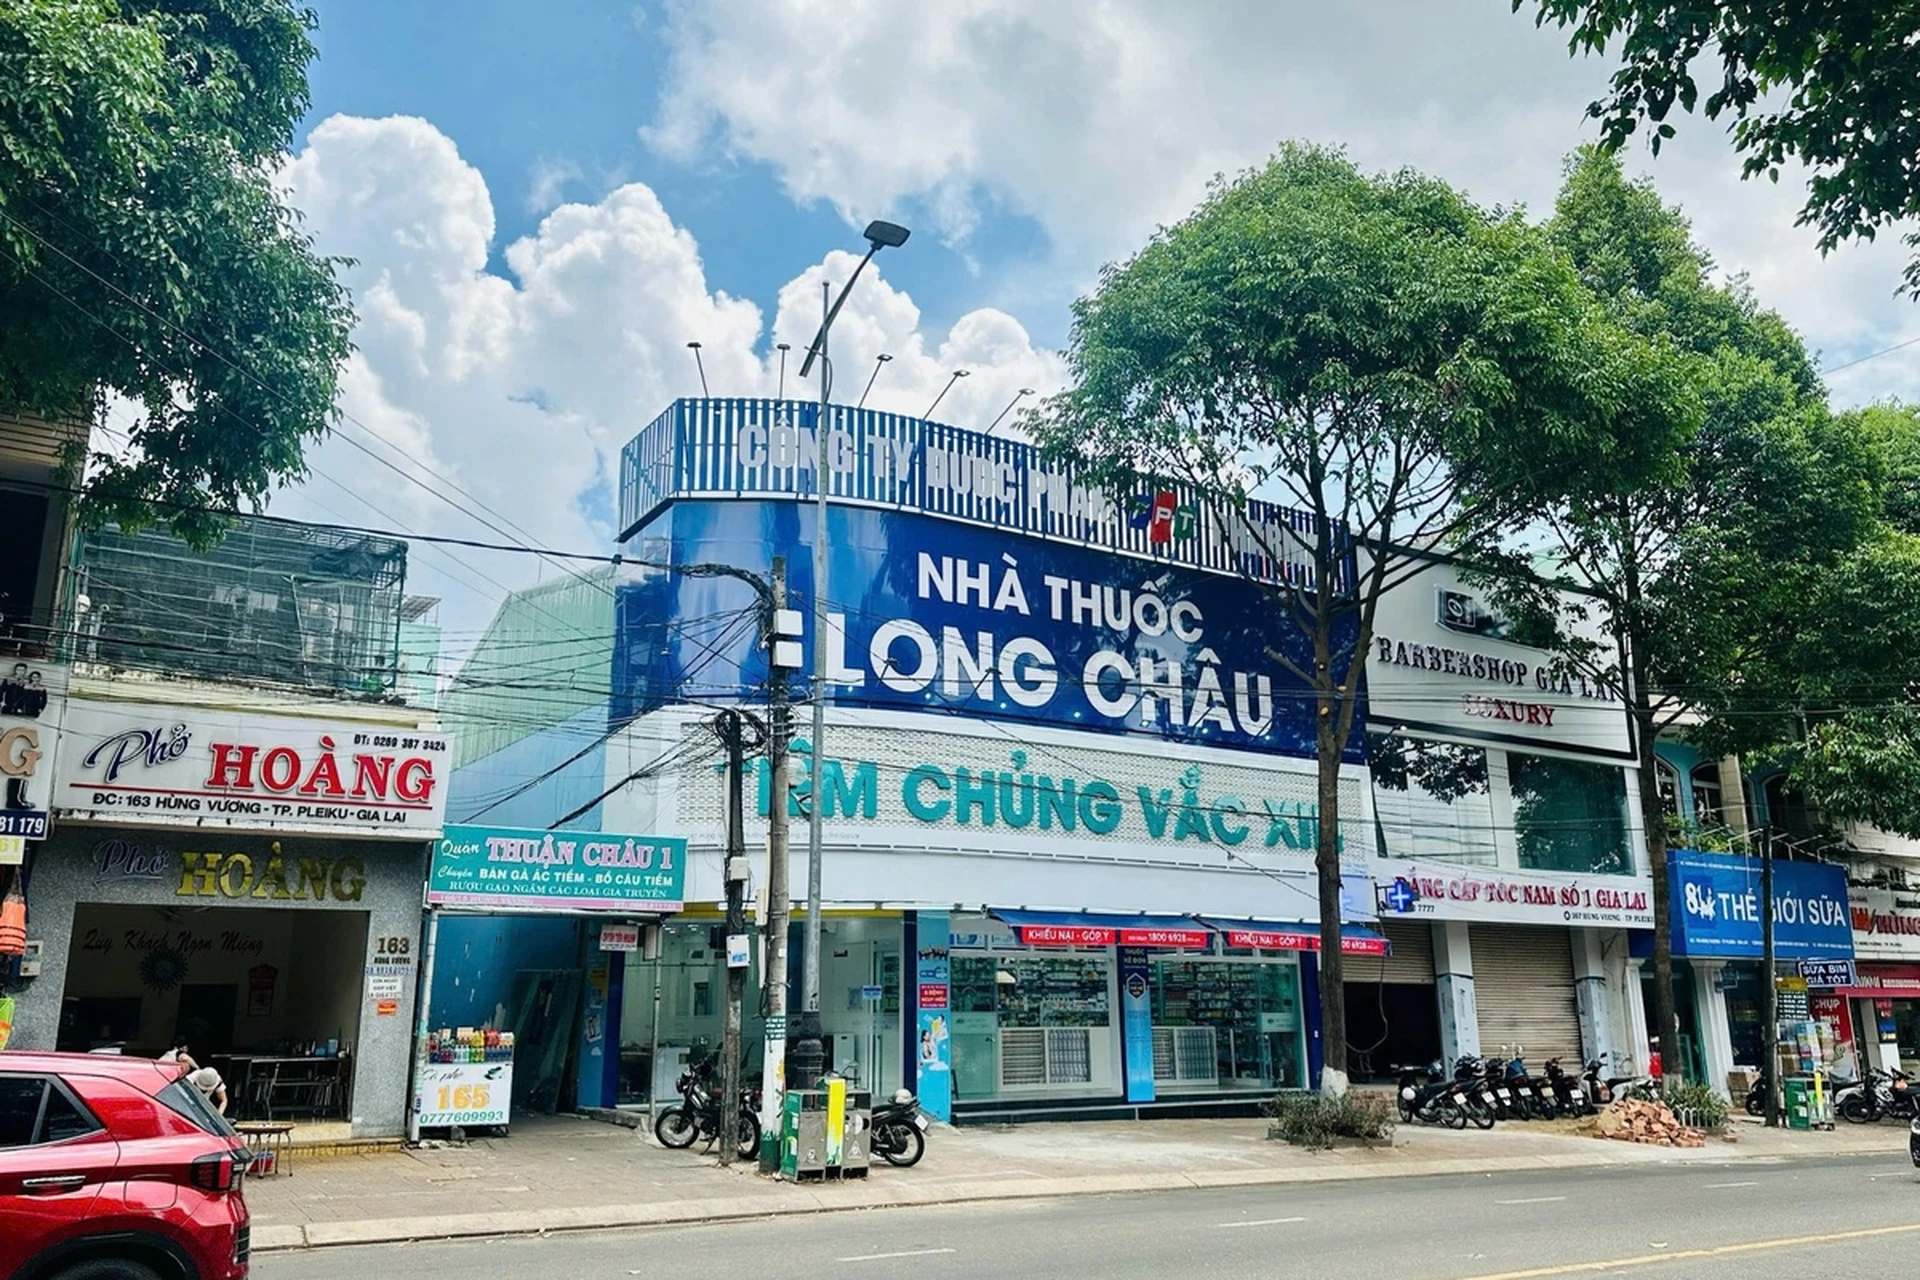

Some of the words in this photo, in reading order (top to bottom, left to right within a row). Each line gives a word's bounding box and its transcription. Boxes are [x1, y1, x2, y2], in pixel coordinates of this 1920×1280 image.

[738, 417, 854, 475] CÔNG
[867, 434, 914, 483] TY
[918, 552, 1031, 616] NHÀ
[1044, 573, 1205, 643] THUỐC
[825, 612, 1059, 707] LONG
[1083, 647, 1273, 737] CHÂU
[1376, 636, 1528, 686] BARBERSHOP
[1535, 665, 1574, 695] GIA
[1462, 694, 1556, 727] LUXURY
[85, 724, 194, 783] Phở
[205, 735, 436, 802] HOÀNG
[126, 794, 151, 808] 163
[155, 793, 201, 811] HÙNG
[207, 800, 262, 815] VƯƠNG
[272, 803, 293, 817] TP.
[297, 806, 349, 820] PLEIKU
[356, 809, 380, 822] GIA
[384, 811, 407, 823] LAI
[902, 749, 1123, 835] CHỦNG
[1136, 763, 1251, 846] VẮC
[19, 817, 45, 834] 179
[440, 838, 480, 860] Quán
[485, 833, 577, 870] THUẬN
[582, 838, 654, 869] CHÂU
[660, 847, 673, 870] 1
[176, 841, 366, 902] HOÀNG
[480, 867, 508, 880] BÁN
[615, 873, 641, 886] CÂU
[603, 888, 622, 896] GIA
[1522, 885, 1557, 906] NAM
[1595, 889, 1622, 910] GIA
[1623, 891, 1648, 911] LAI
[1718, 887, 1759, 922] THẾ
[1807, 894, 1847, 927] SỮA
[377, 936, 410, 954] 163
[1148, 933, 1168, 943] 1800
[1168, 934, 1187, 943] 6928
[1341, 941, 1351, 949] 00
[437, 1084, 490, 1110] 165
[420, 1110, 504, 1124] 0777609993
